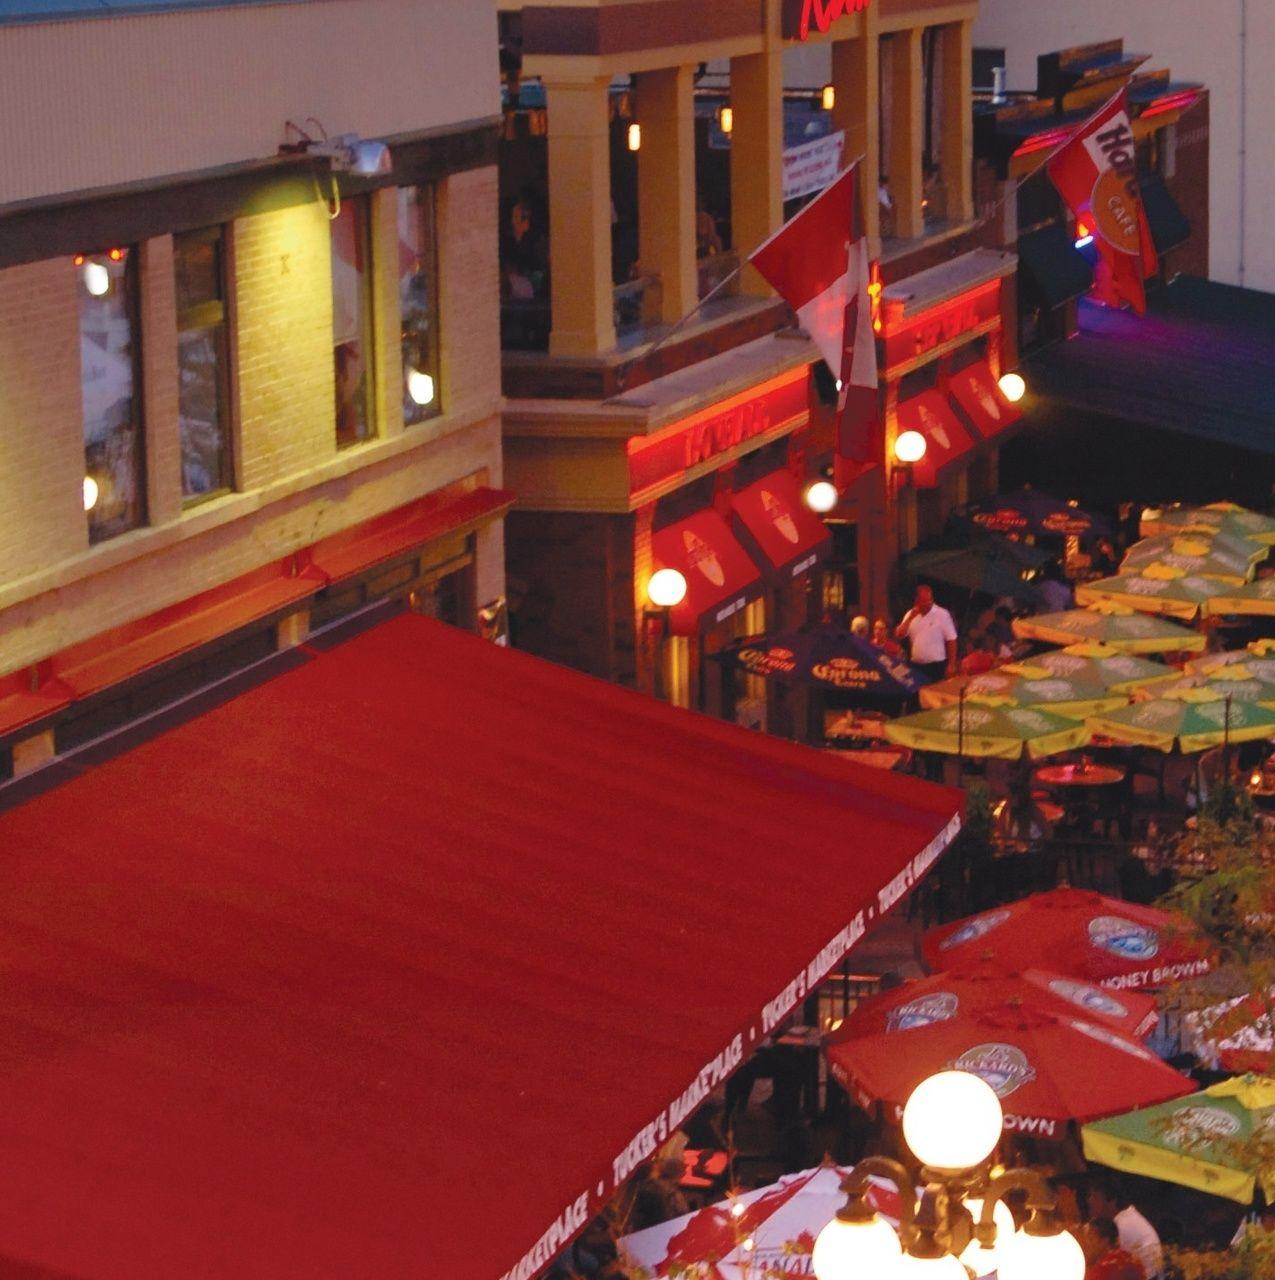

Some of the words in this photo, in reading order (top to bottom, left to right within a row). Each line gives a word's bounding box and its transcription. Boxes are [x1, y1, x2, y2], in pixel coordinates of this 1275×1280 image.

[812, 663, 882, 682] Corona
[761, 968, 807, 1035] TUCKER'S
[613, 1111, 667, 1187] TUCKER'S
[669, 1032, 743, 1133] MARKETPLACE
[1001, 1114, 1056, 1137] OWN
